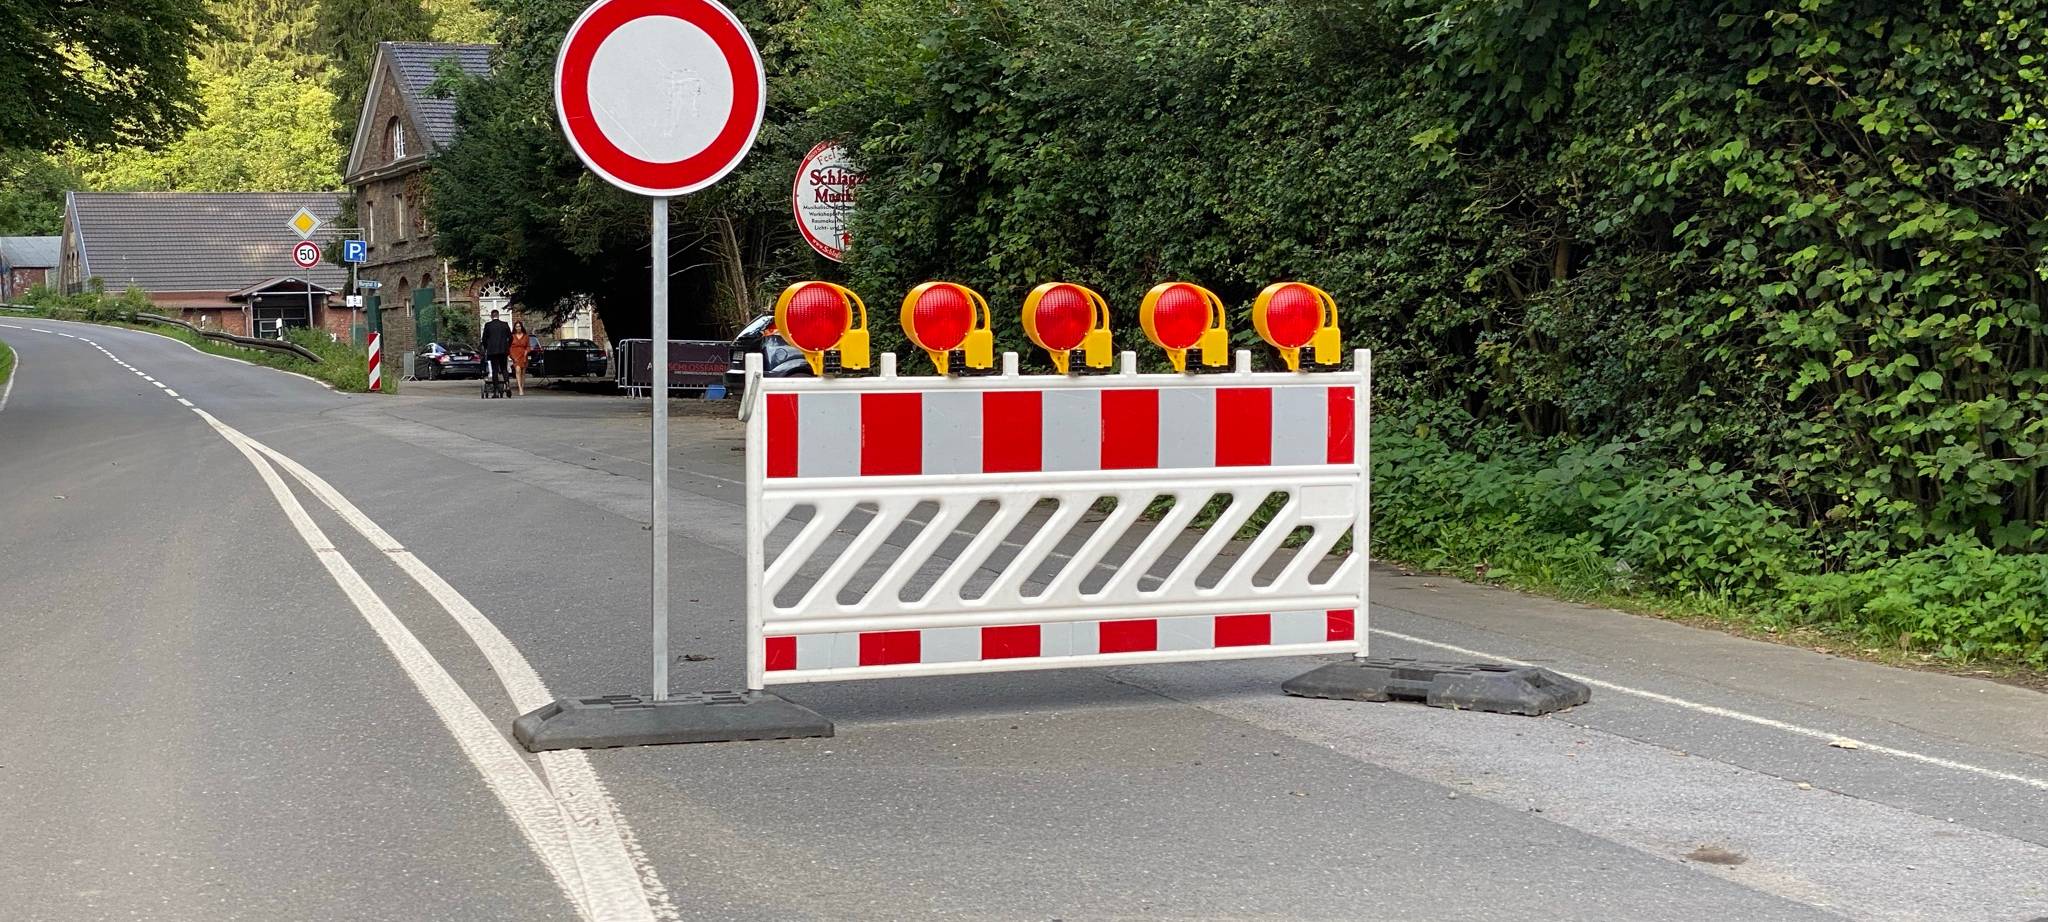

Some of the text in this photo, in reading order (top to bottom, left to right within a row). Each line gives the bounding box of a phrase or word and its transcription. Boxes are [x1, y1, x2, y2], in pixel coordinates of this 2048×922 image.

[810, 169, 868, 188] Schlagze
[814, 188, 855, 203] Musik
[300, 249, 315, 260] 50
[349, 243, 362, 259] P
